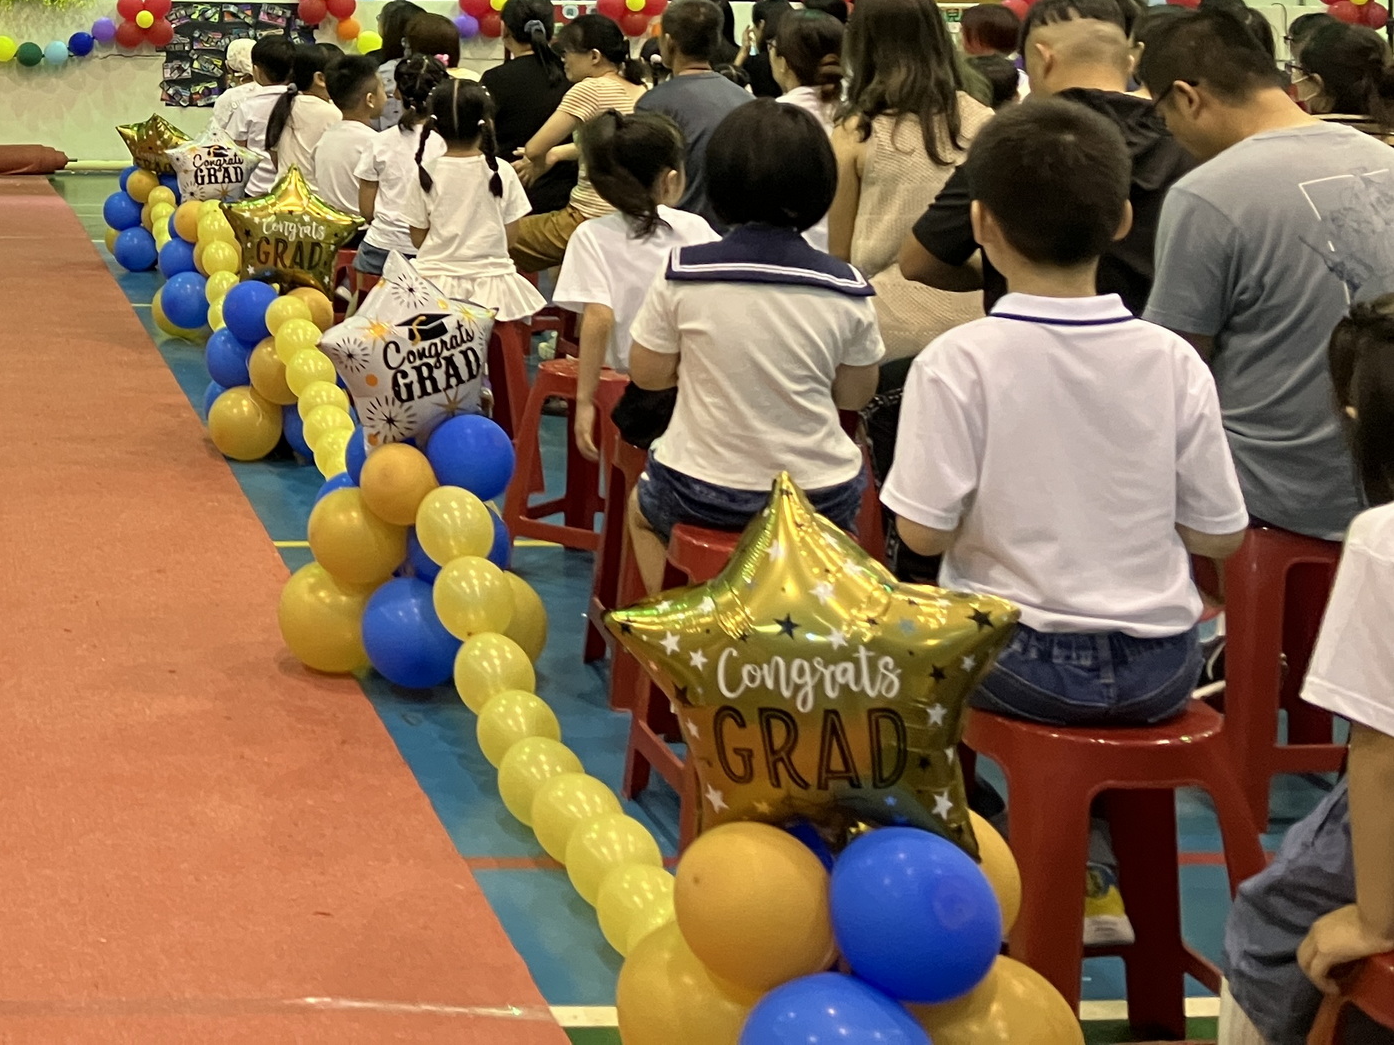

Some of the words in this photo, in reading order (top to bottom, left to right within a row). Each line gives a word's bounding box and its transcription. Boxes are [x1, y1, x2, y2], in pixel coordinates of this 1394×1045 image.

[193, 152, 244, 172] Congrats
[194, 166, 244, 185] GRAD
[262, 214, 326, 241] Congrats
[256, 236, 323, 270] GRAD
[383, 319, 474, 370] Congrats
[392, 347, 482, 403] GRAD
[717, 645, 901, 713] Congrats
[713, 704, 907, 791] GRAD
